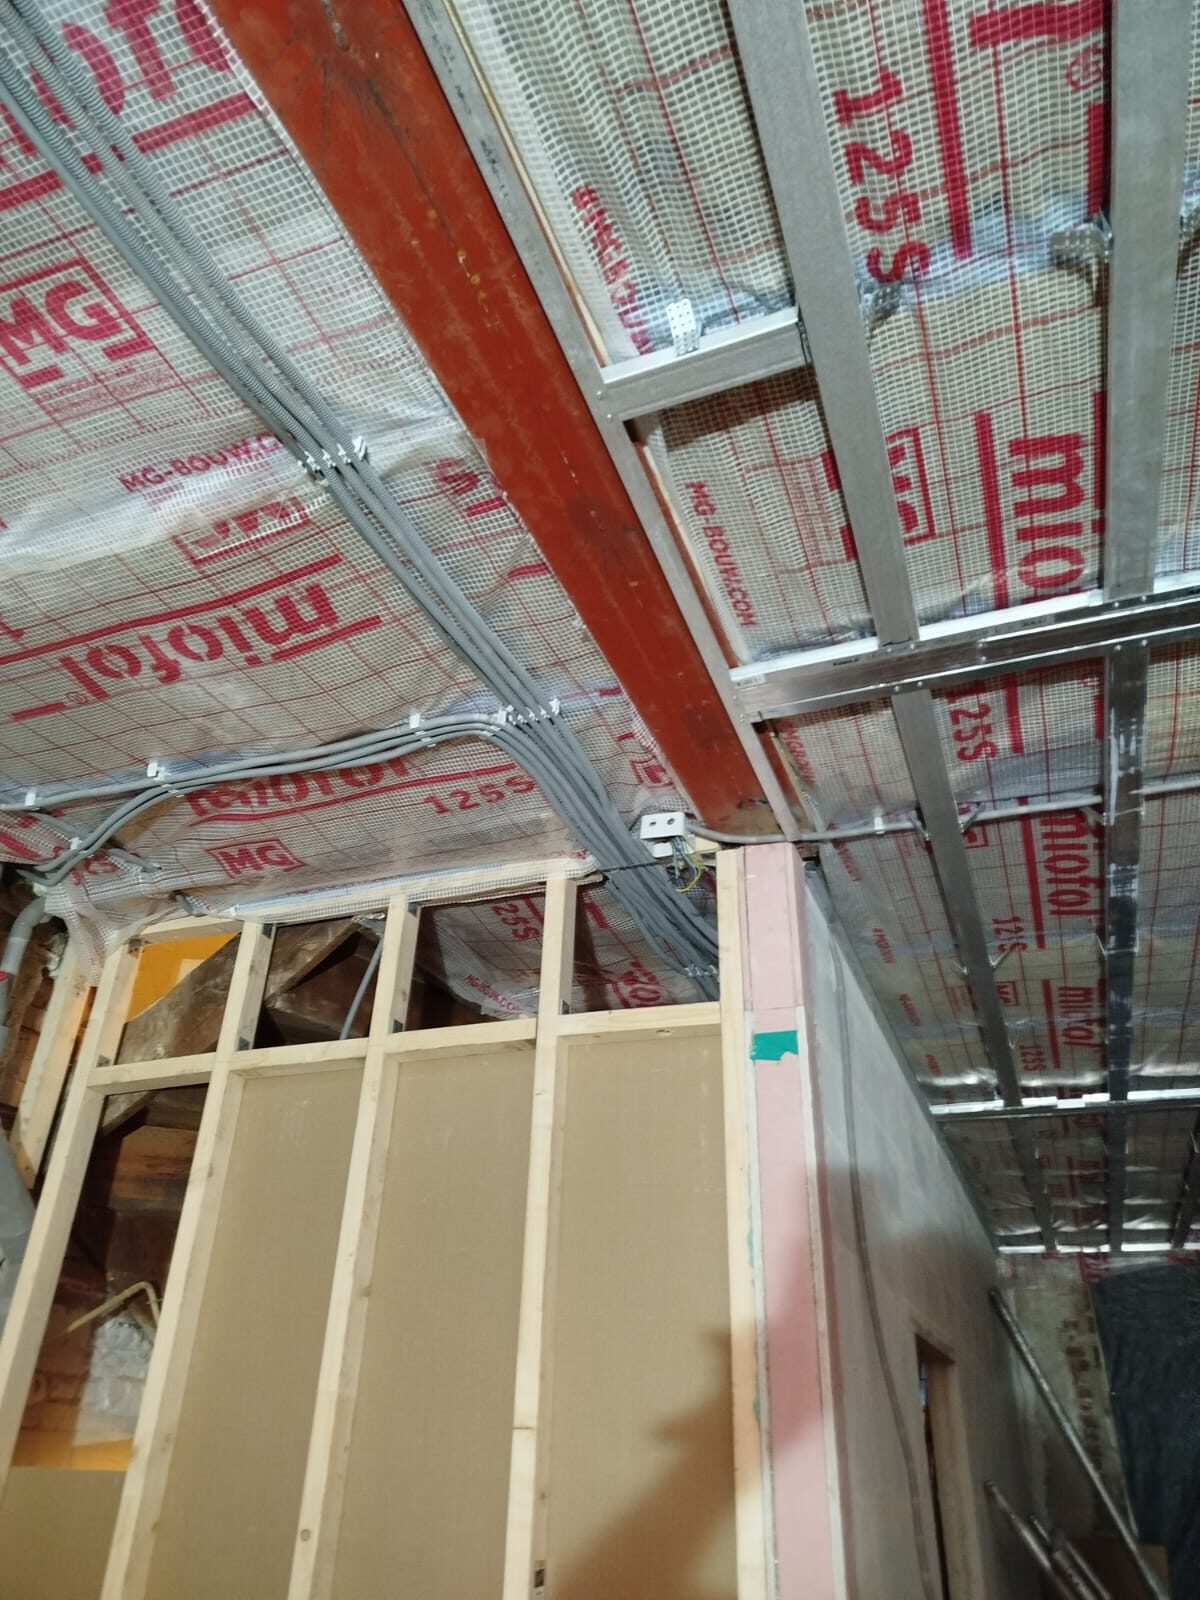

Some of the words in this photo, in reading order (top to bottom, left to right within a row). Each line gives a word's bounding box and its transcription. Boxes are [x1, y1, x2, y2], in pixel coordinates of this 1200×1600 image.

[833, 66, 931, 283] 125S
[0, 278, 126, 366] MG
[1008, 431, 1092, 603] mio
[58, 583, 340, 701] miofol
[423, 773, 536, 815] 125S
[217, 845, 296, 876] MG
